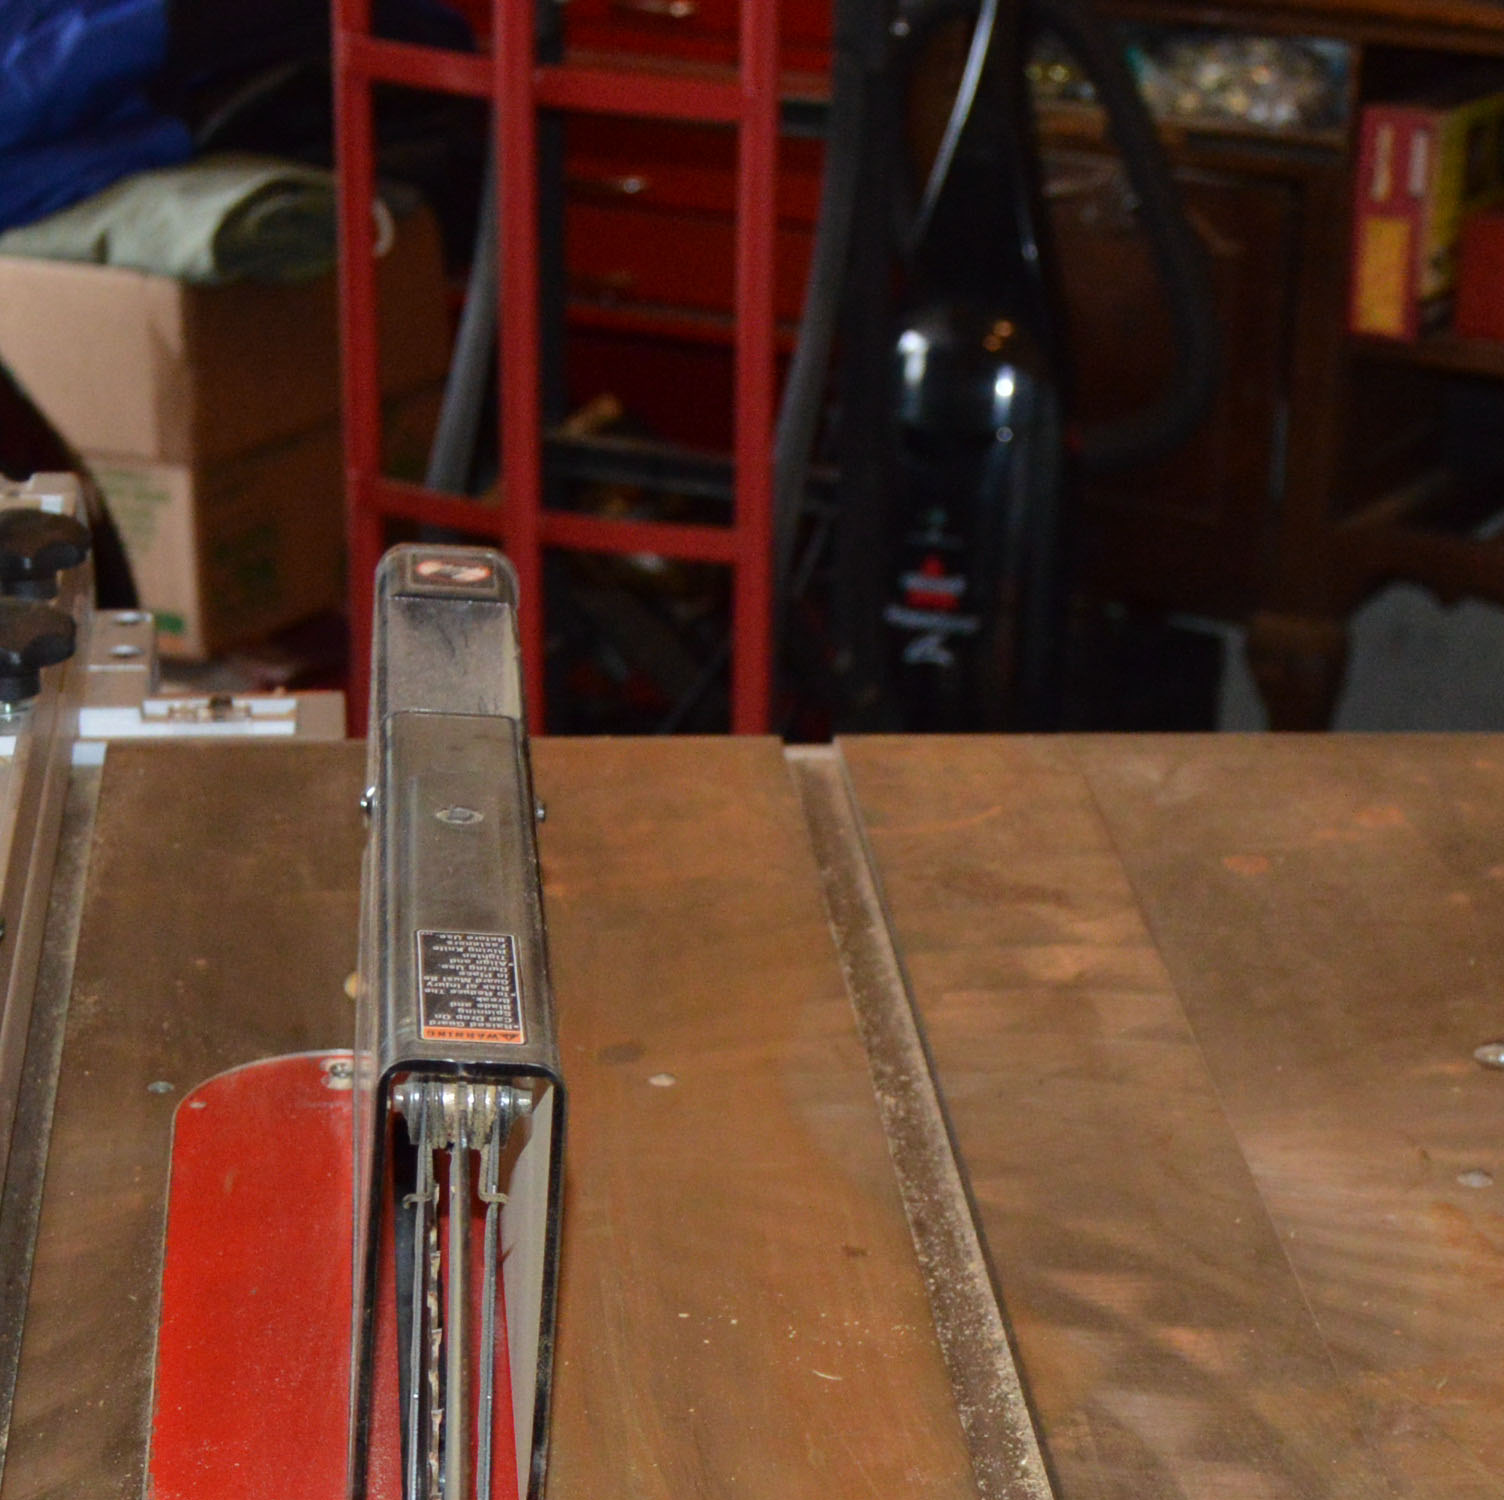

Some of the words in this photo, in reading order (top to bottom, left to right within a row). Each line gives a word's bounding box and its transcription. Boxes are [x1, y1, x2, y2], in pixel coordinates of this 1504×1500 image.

[446, 940, 507, 948] Fasteners
[458, 1008, 511, 1016] Spinning
[427, 1030, 498, 1038] WARNING
